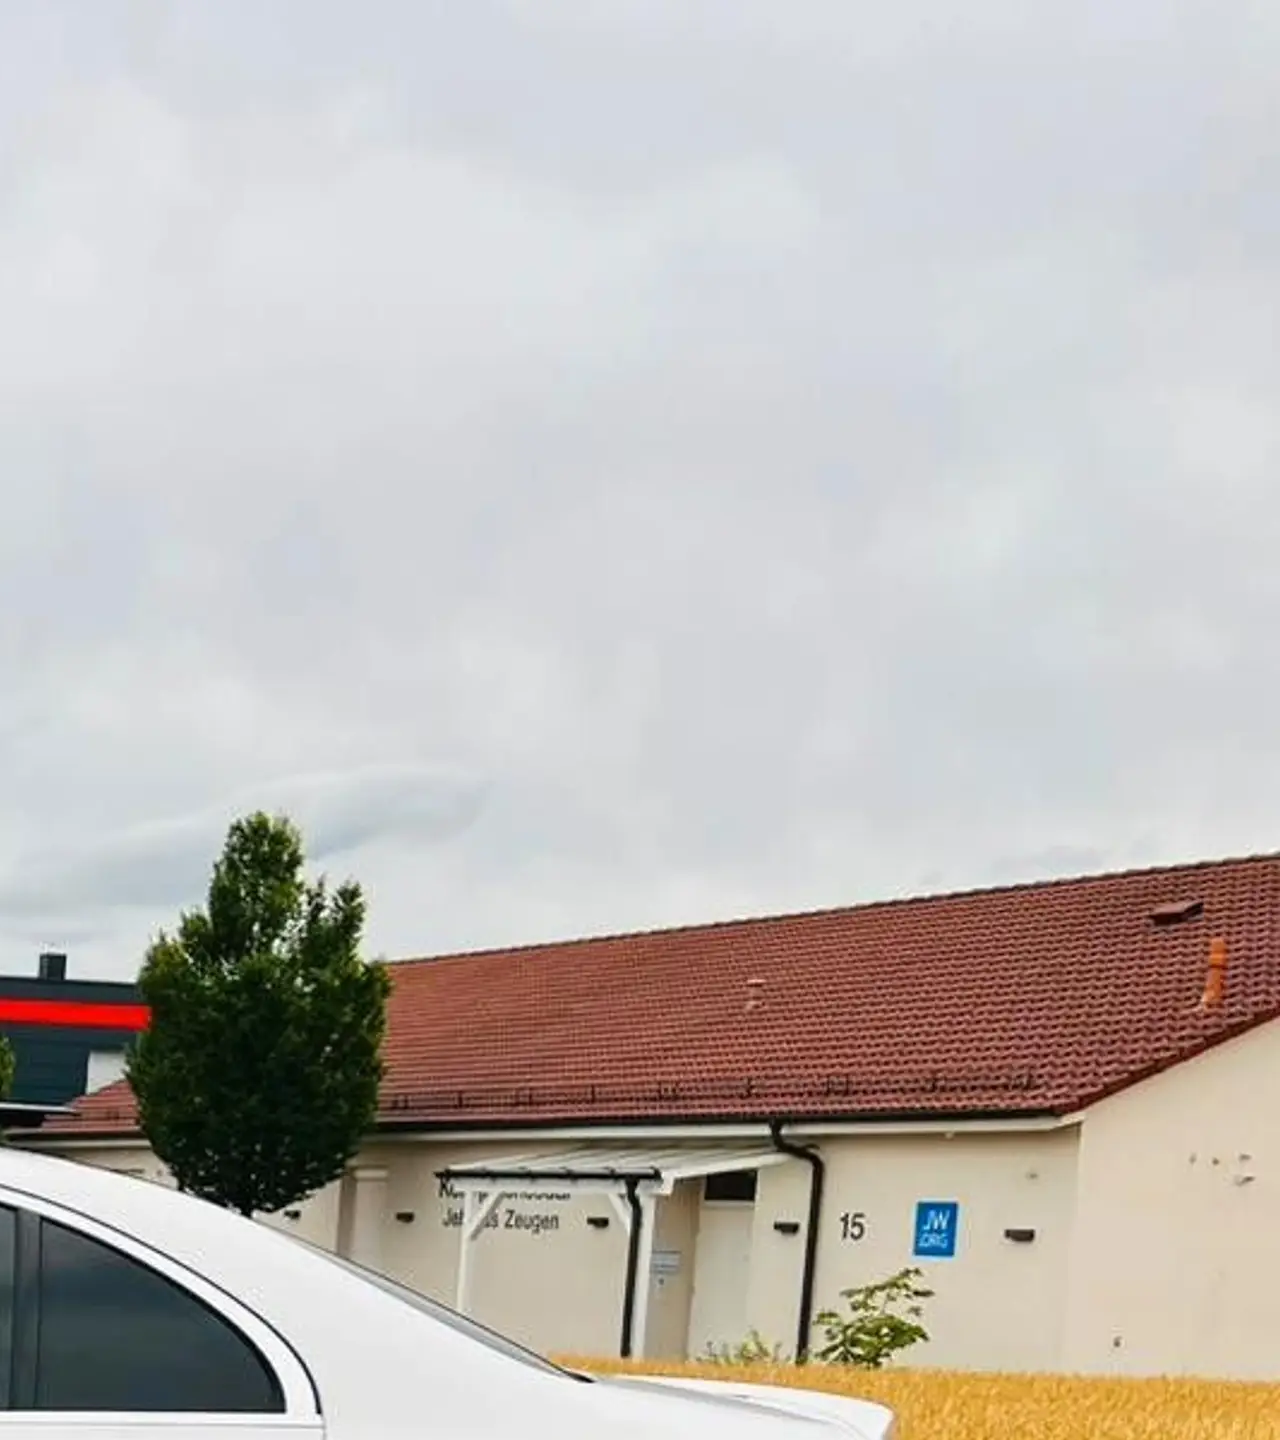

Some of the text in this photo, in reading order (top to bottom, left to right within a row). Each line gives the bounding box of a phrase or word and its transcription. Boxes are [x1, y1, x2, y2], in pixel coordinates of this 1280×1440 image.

[504, 1209, 559, 1234] Zeugen
[840, 1212, 865, 1241] 15
[922, 1209, 951, 1231] JW
